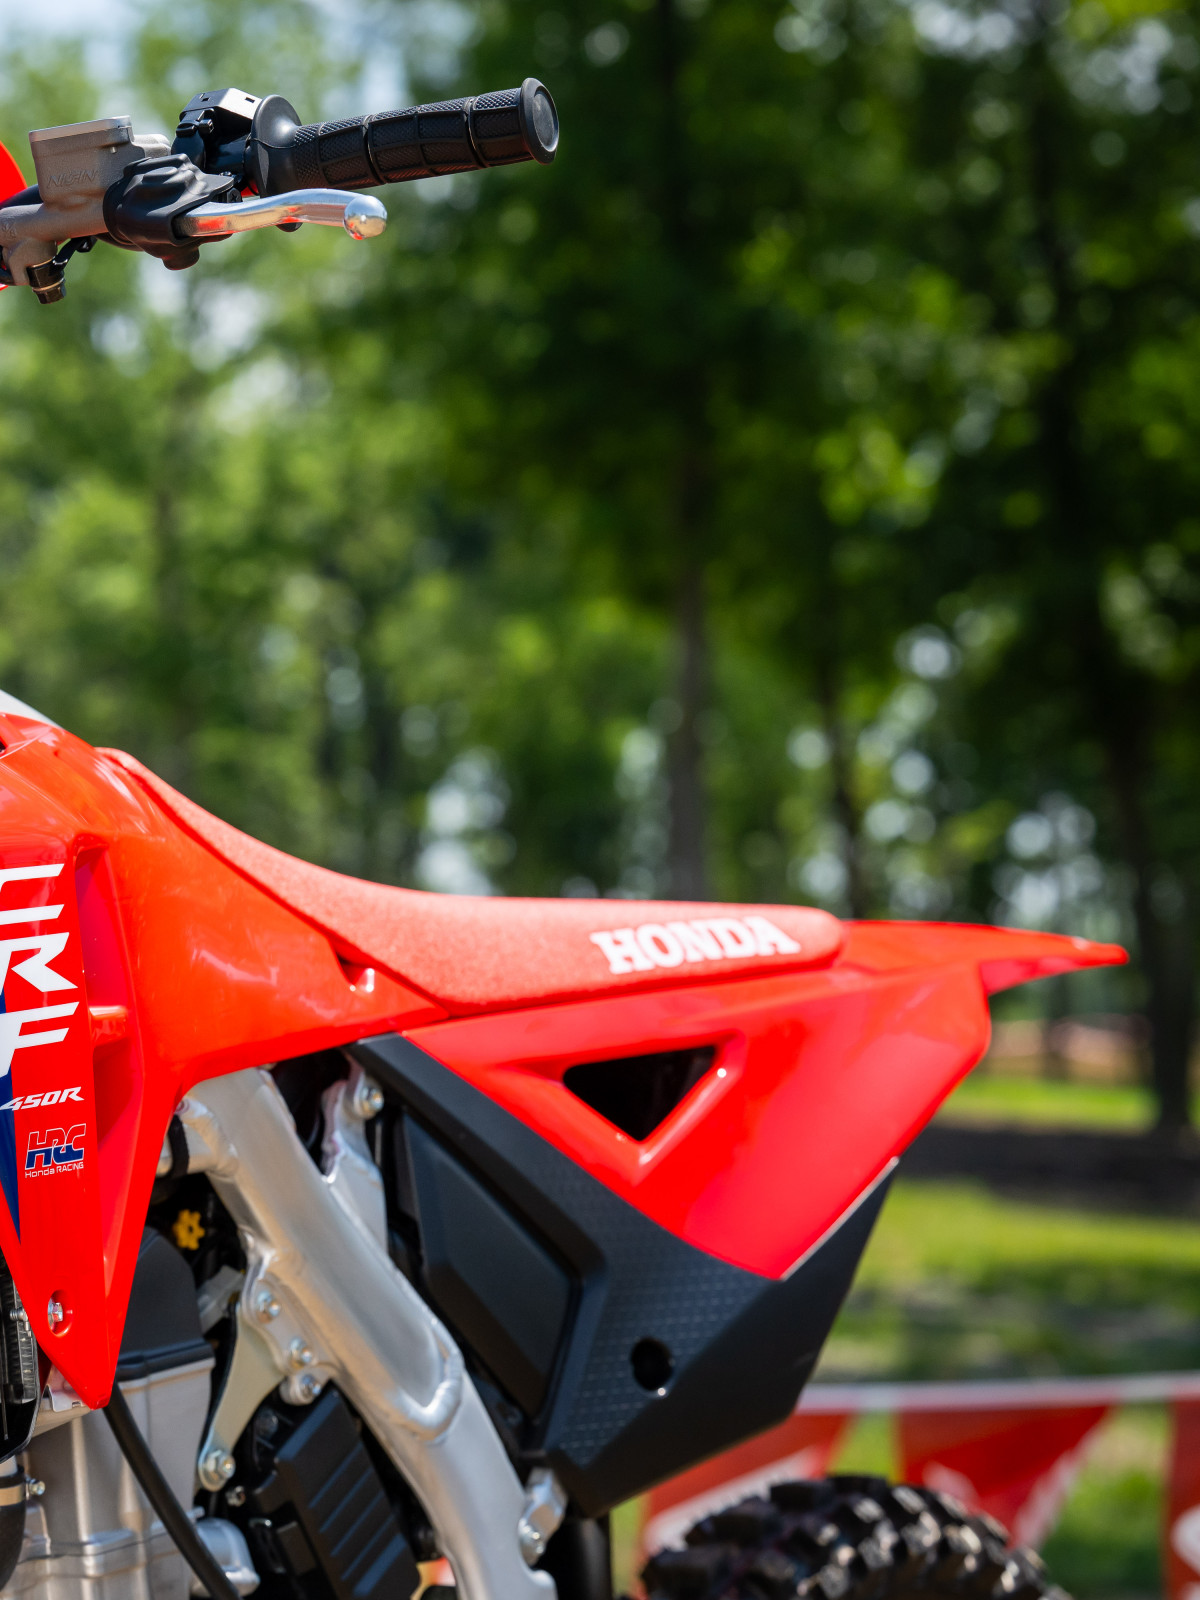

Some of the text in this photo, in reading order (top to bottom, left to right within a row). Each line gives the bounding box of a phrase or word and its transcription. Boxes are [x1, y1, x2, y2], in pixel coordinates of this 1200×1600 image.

[589, 916, 801, 975] HONDA
[25, 1123, 87, 1170] HRC
[25, 1161, 84, 1178] Honda RACING
